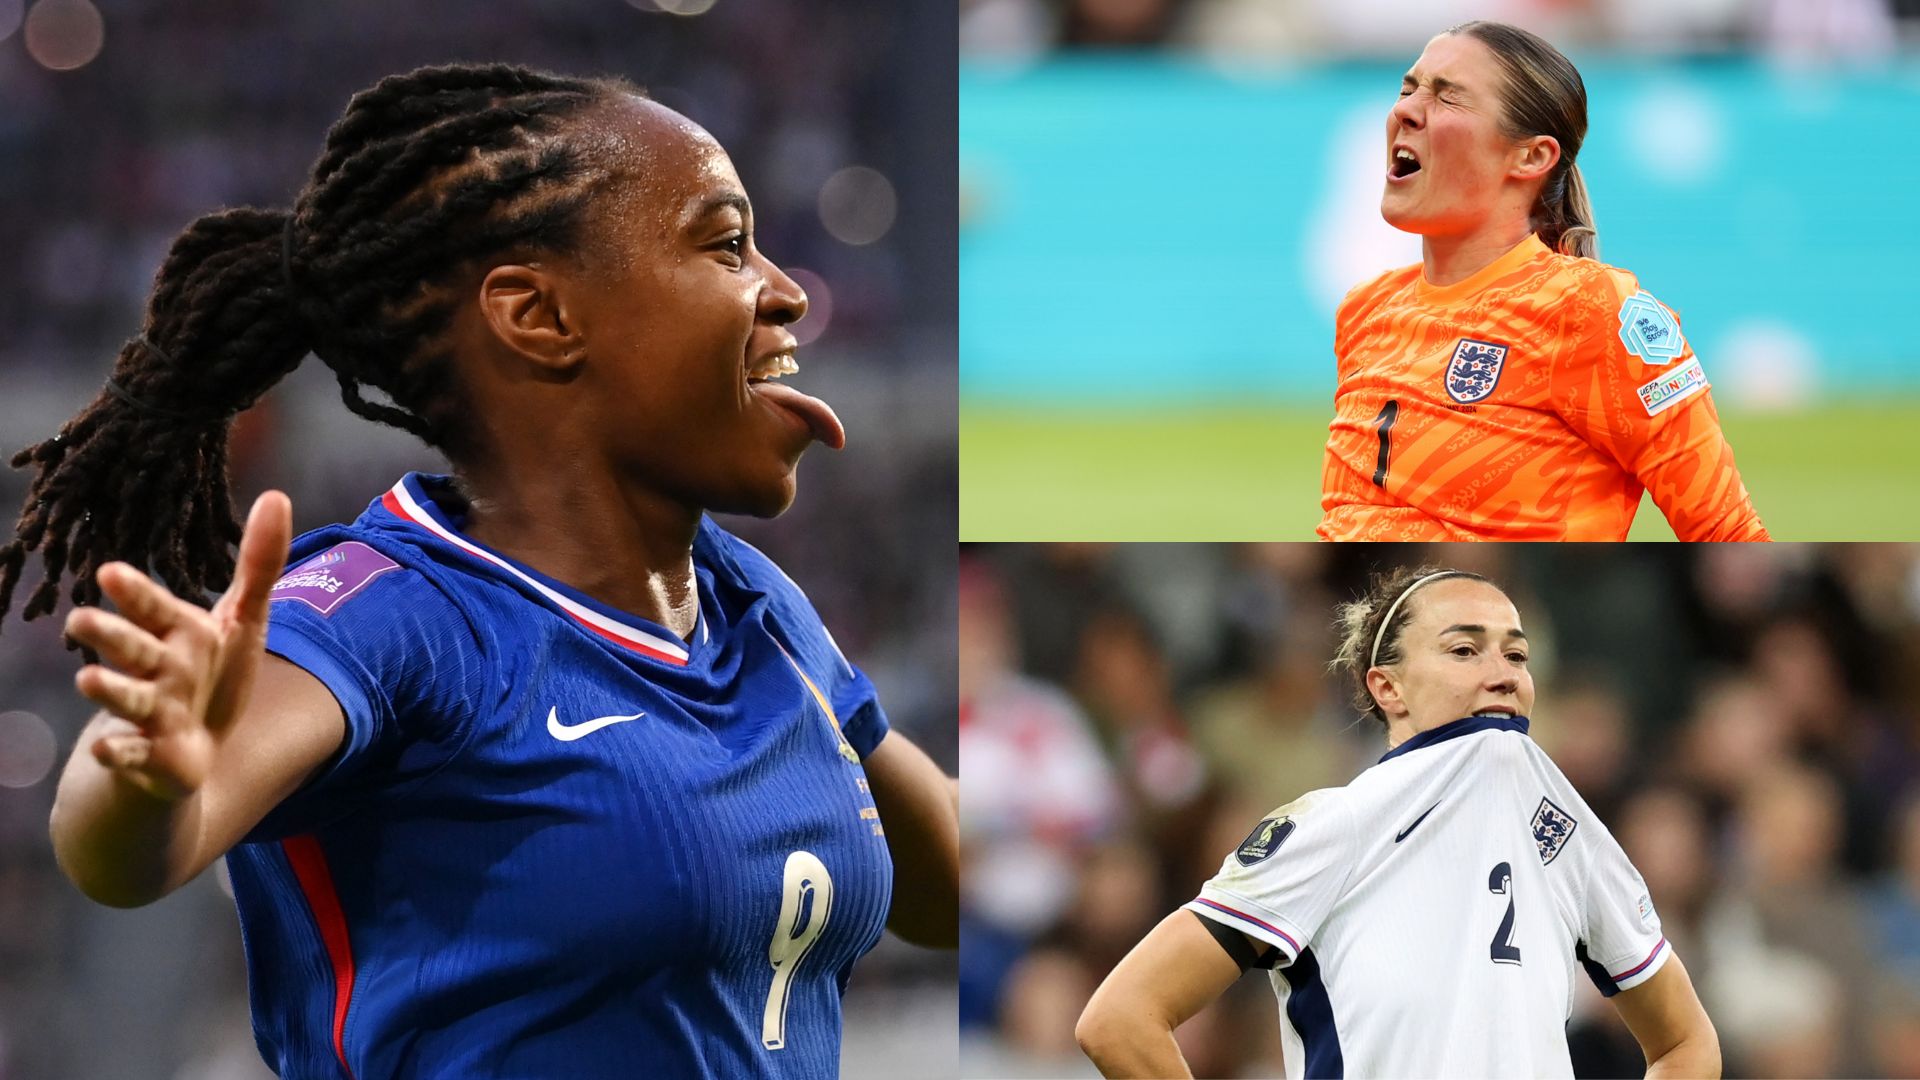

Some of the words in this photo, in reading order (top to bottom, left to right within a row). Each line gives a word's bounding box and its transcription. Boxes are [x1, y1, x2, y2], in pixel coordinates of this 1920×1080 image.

[1640, 382, 1659, 397] UEFA
[1643, 367, 1701, 406] FOUNDATIO
[1373, 400, 1400, 490] 1
[762, 850, 833, 1049] 9
[1488, 861, 1521, 966] 2
